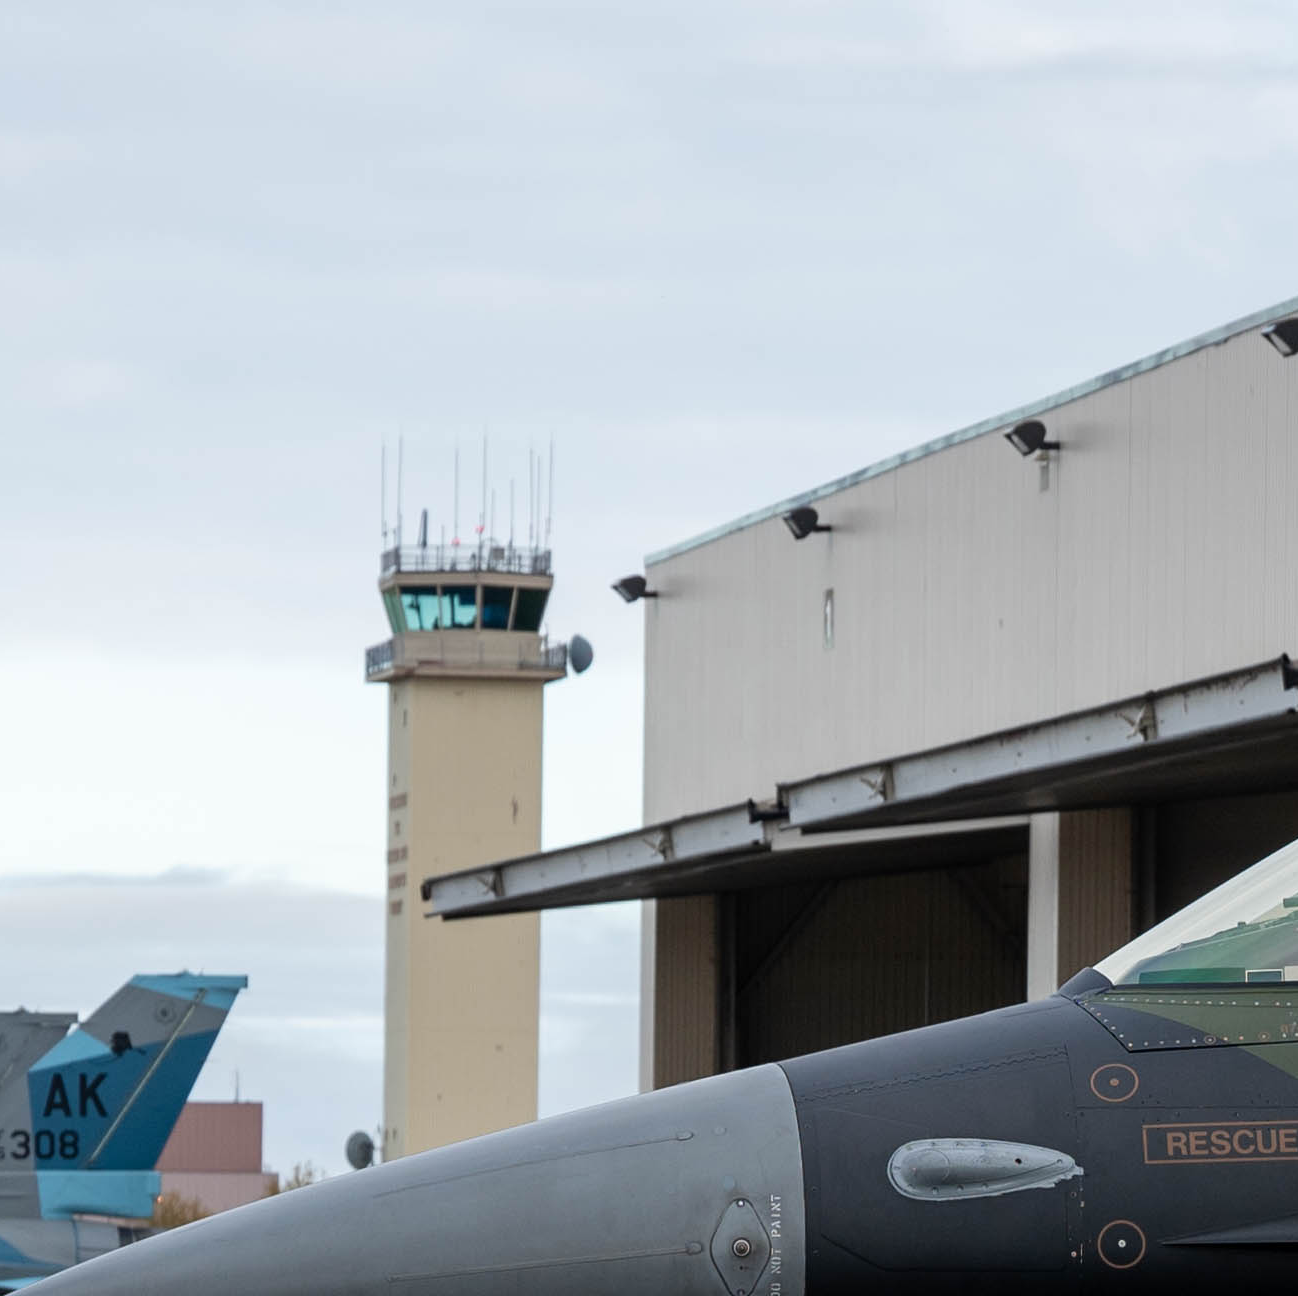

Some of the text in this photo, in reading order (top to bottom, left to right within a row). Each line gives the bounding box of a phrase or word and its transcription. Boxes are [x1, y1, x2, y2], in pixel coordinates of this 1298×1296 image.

[43, 1072, 107, 1117] AK
[10, 1130, 79, 1160] 308
[1166, 1128, 1298, 1156] RESCUE
[770, 1194, 781, 1237] PAINT
[770, 1248, 781, 1274] NOT
